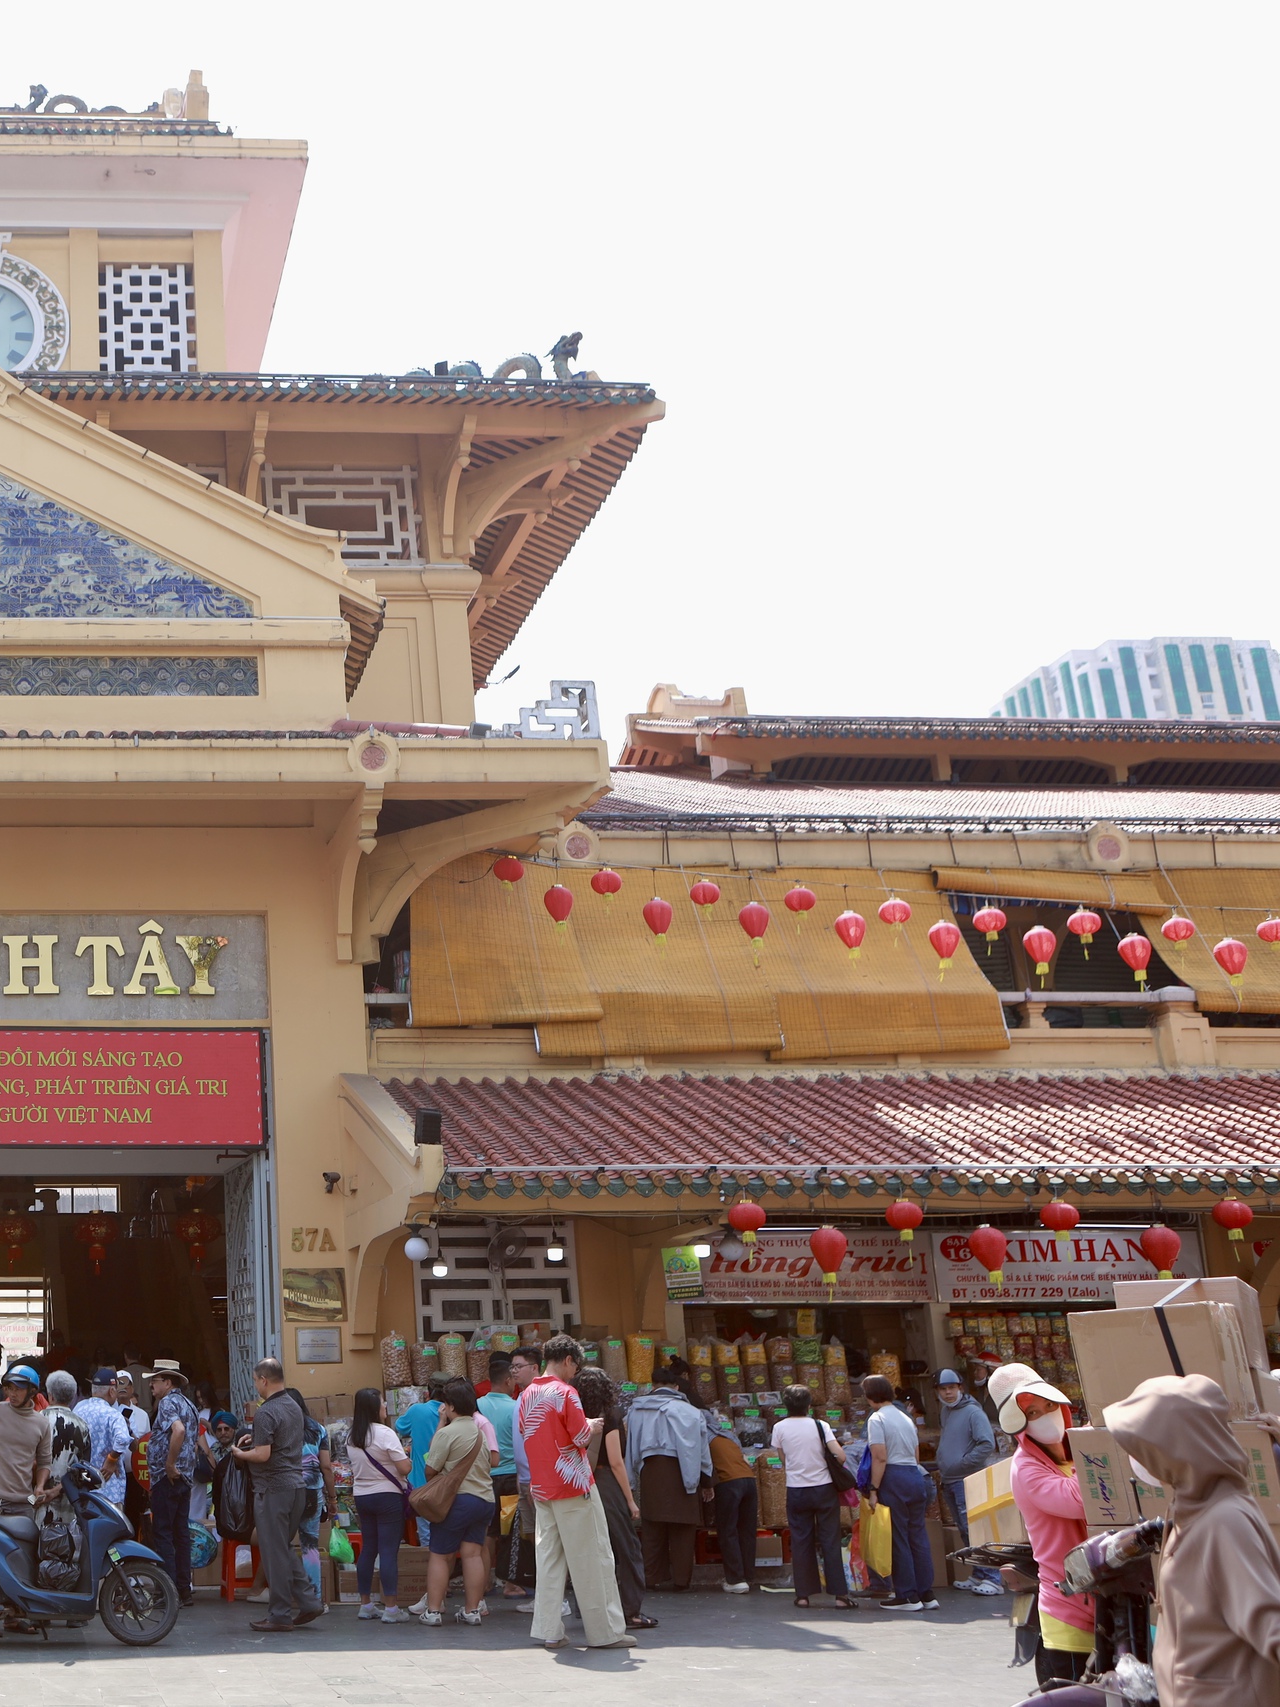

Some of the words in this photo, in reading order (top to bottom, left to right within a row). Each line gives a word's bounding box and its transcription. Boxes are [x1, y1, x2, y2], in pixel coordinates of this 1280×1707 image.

[75, 919, 229, 996] TÂY
[37, 1047, 77, 1068] MỚI
[82, 1046, 137, 1068] SÁNG
[140, 1051, 183, 1070] TẠO
[34, 1075, 87, 1096] PHÁT
[91, 1074, 151, 1096] TRIỂN
[155, 1075, 192, 1096] GIÁ
[195, 1079, 228, 1099] TRỊ
[53, 1105, 99, 1126] VIỆT
[102, 1106, 153, 1124] NAM
[291, 1226, 337, 1253] 57A
[946, 1238, 968, 1248] SẠP
[948, 1247, 972, 1260] 16
[1070, 1238, 1150, 1269] HẠN
[956, 1273, 987, 1282] CHUYÊN
[1035, 1273, 1056, 1283] THỰC
[952, 1287, 968, 1298] ĐT
[1040, 1287, 1065, 1298] 229
[1067, 1287, 1100, 1299] (Zalo)
[138, 1469, 149, 1481] XE
